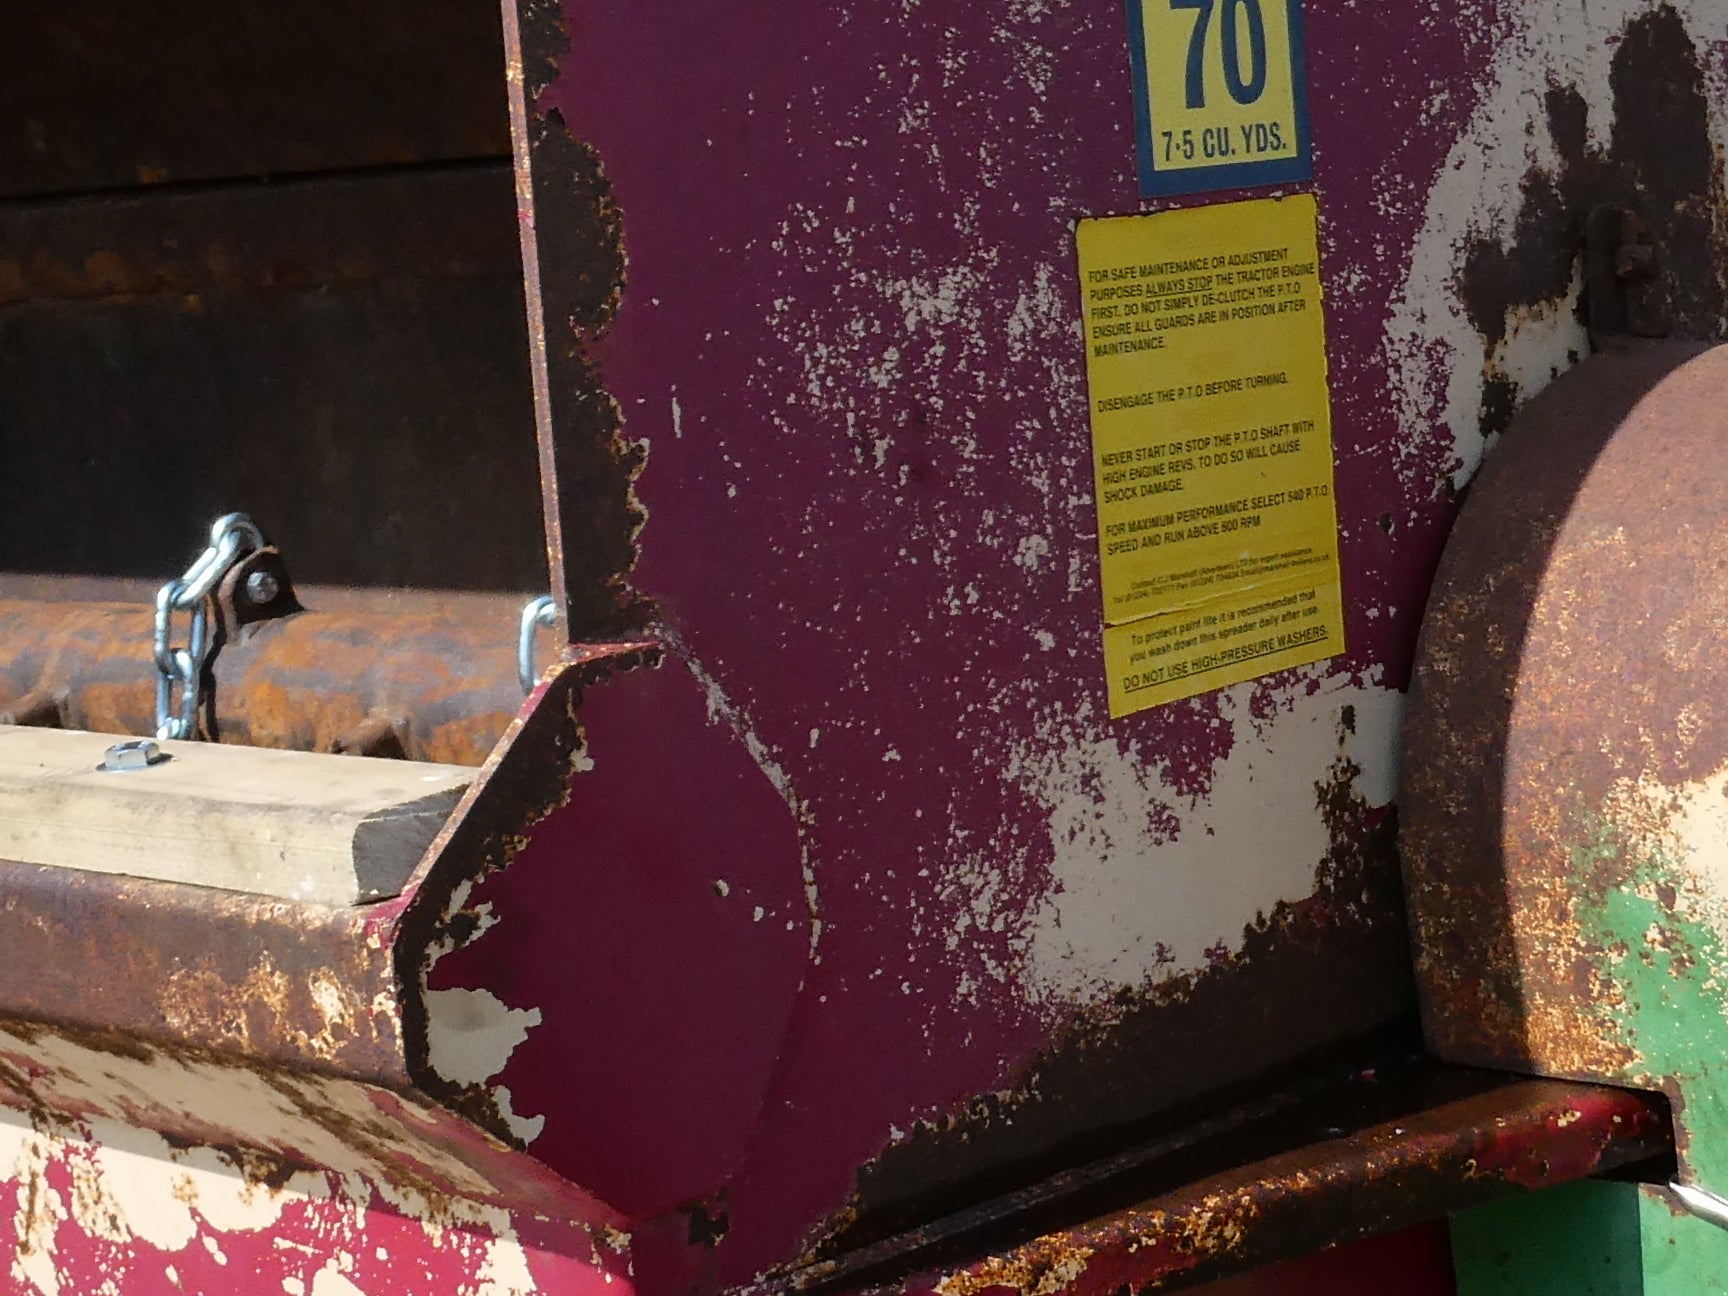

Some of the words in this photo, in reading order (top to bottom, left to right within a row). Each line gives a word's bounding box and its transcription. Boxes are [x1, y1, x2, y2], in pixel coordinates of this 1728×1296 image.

[1202, 126, 1236, 159] CU.
[1240, 121, 1288, 153] YDS.
[1088, 270, 1108, 283] FOR
[1111, 266, 1137, 281] SAFE
[1139, 258, 1209, 278] MAINTENANCE
[1212, 256, 1225, 269] OR
[1228, 248, 1288, 266] ADJUSTMENT
[1090, 284, 1143, 301] PURPOSES
[1146, 279, 1185, 295] ALWAYS
[1187, 275, 1213, 290] STOP
[1215, 272, 1234, 286] THE
[1236, 267, 1279, 284] TRACTOR
[1281, 262, 1315, 278] ENGINE
[1092, 321, 1132, 339] ENSURE
[1135, 320, 1152, 333] ALL
[1154, 313, 1195, 331] GUARDS
[1197, 311, 1217, 325] ARE
[1219, 309, 1229, 322] IN
[1231, 303, 1276, 320] POSITION
[1278, 299, 1306, 313] AFTER
[1124, 303, 1138, 316] DO
[1141, 300, 1161, 313] NOT
[1163, 294, 1199, 311] SIMPLY
[1257, 284, 1275, 298] THE
[1098, 392, 1154, 412] DISENGAGE
[1156, 389, 1175, 402] THE
[1205, 378, 1243, 396] BEFORE
[1101, 450, 1133, 467] NEVER
[1136, 444, 1166, 461] START
[1168, 442, 1183, 456] OR
[1185, 437, 1211, 453] STOP
[1213, 433, 1232, 448] THE
[1260, 424, 1290, 440] SHAFT
[1291, 420, 1314, 434] WITH
[1103, 470, 1126, 484] HIGH
[1129, 463, 1165, 480] ENGINE
[1198, 455, 1212, 468] TO
[1214, 452, 1228, 466] DO
[1230, 449, 1244, 463] SO
[1246, 446, 1268, 460] WILL
[1269, 440, 1301, 456] CAUSE
[1104, 486, 1138, 503] SHOCK
[1105, 522, 1126, 536] FOR
[1128, 514, 1175, 532] MAXIMUM
[1176, 499, 1249, 523] PERFORMANCE
[1251, 492, 1286, 510] SELECT
[1107, 538, 1139, 556] SPEED
[1141, 534, 1161, 548] AND
[1164, 530, 1185, 544] RUN
[1187, 522, 1219, 539] ABOVE
[1240, 515, 1261, 528] RPM
[1123, 674, 1140, 690] DO
[1142, 667, 1164, 684] NOT
[1166, 661, 1189, 678] USE
